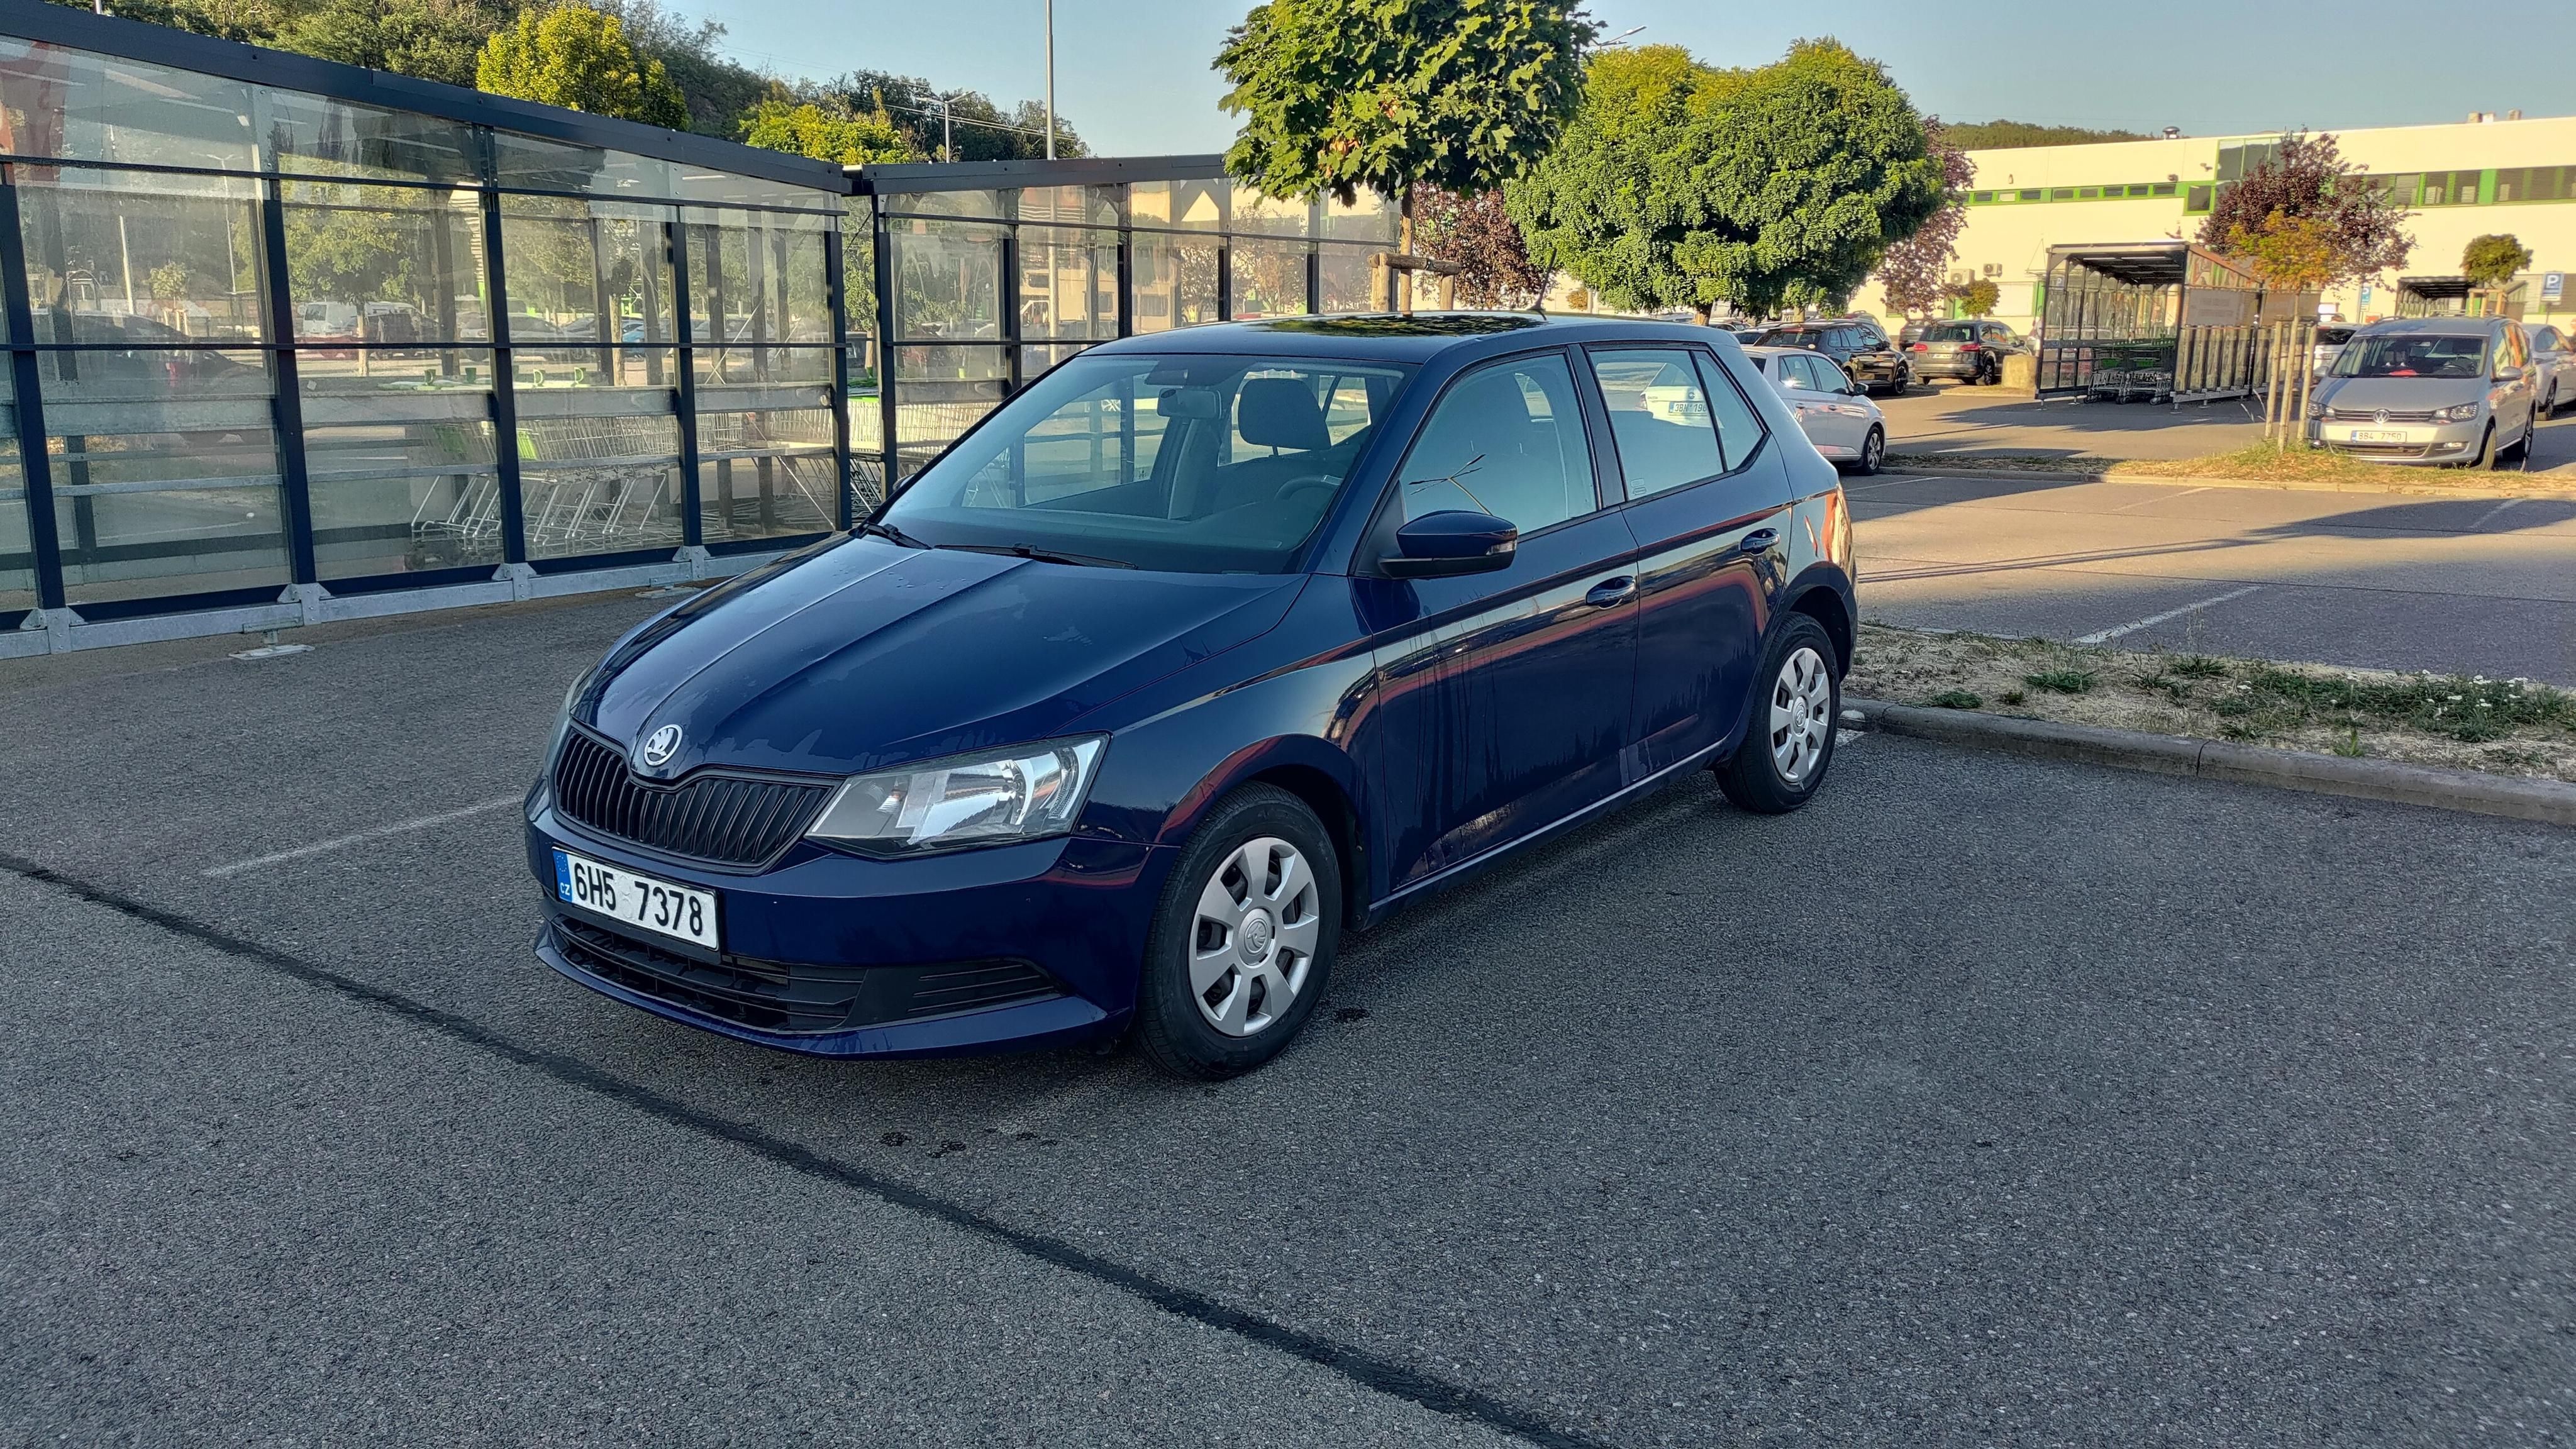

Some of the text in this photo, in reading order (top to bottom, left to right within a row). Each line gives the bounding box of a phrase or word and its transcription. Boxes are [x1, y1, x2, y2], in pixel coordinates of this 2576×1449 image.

[2546, 275, 2558, 288] P
[560, 882, 570, 896] CZ
[574, 862, 703, 936] 6H5 7378
